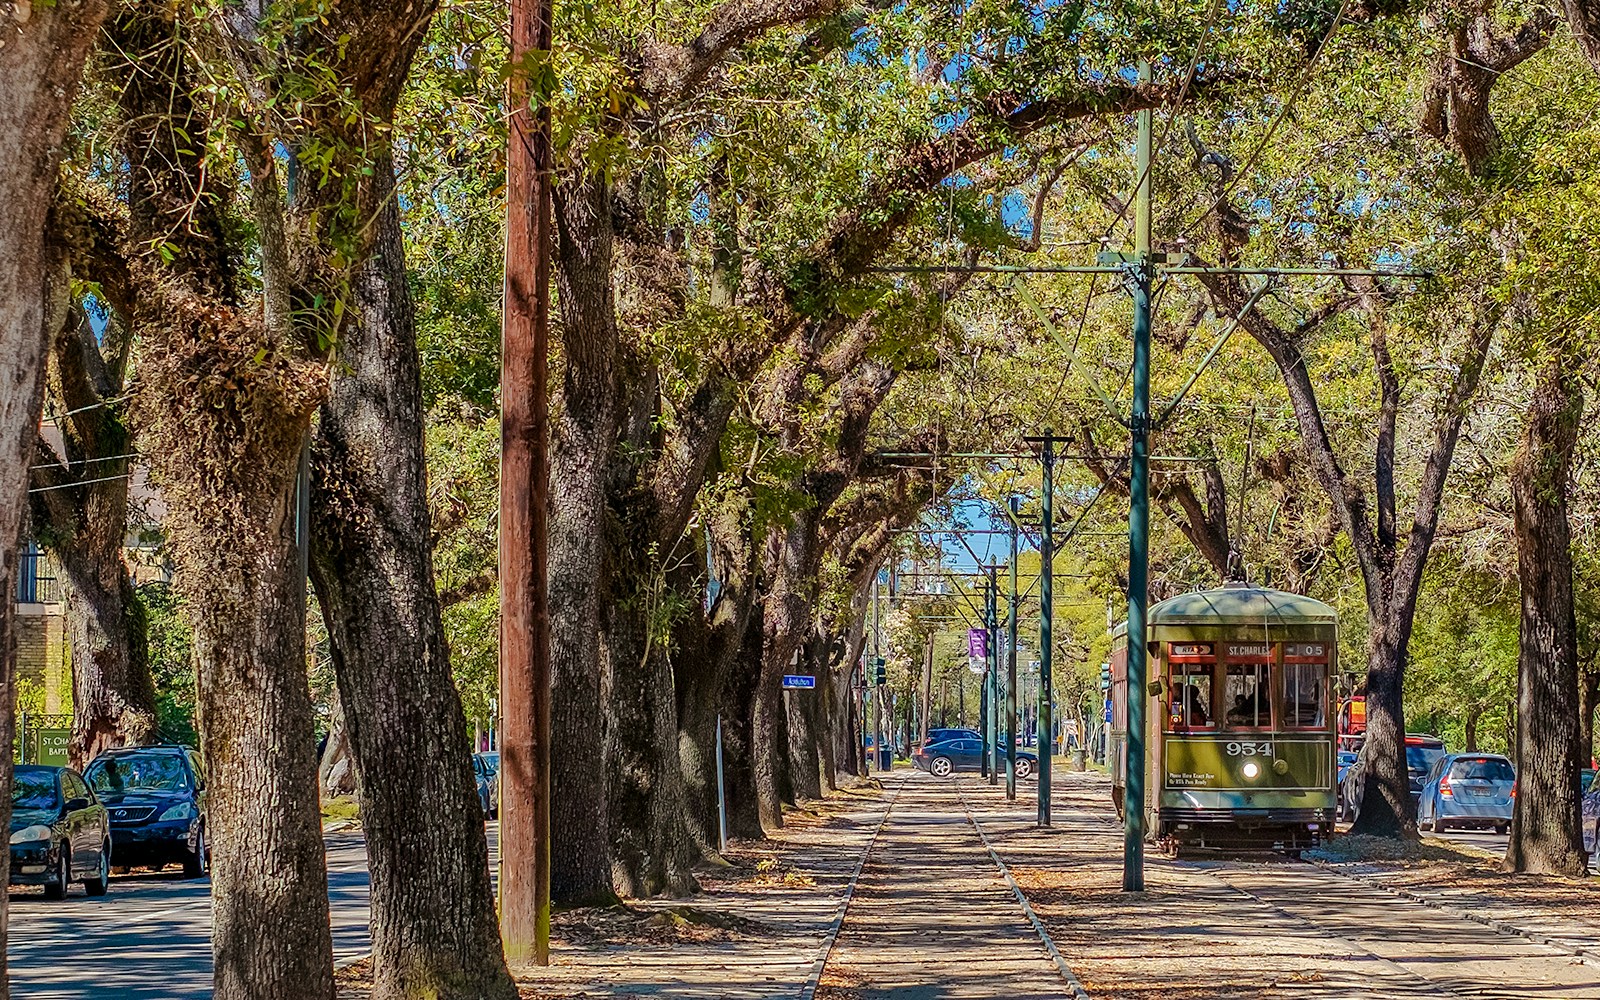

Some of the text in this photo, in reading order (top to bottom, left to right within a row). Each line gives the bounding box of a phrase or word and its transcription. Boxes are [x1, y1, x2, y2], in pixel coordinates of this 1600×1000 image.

[1229, 646, 1270, 655] ST. CHARLES
[1226, 742, 1272, 756] 954
